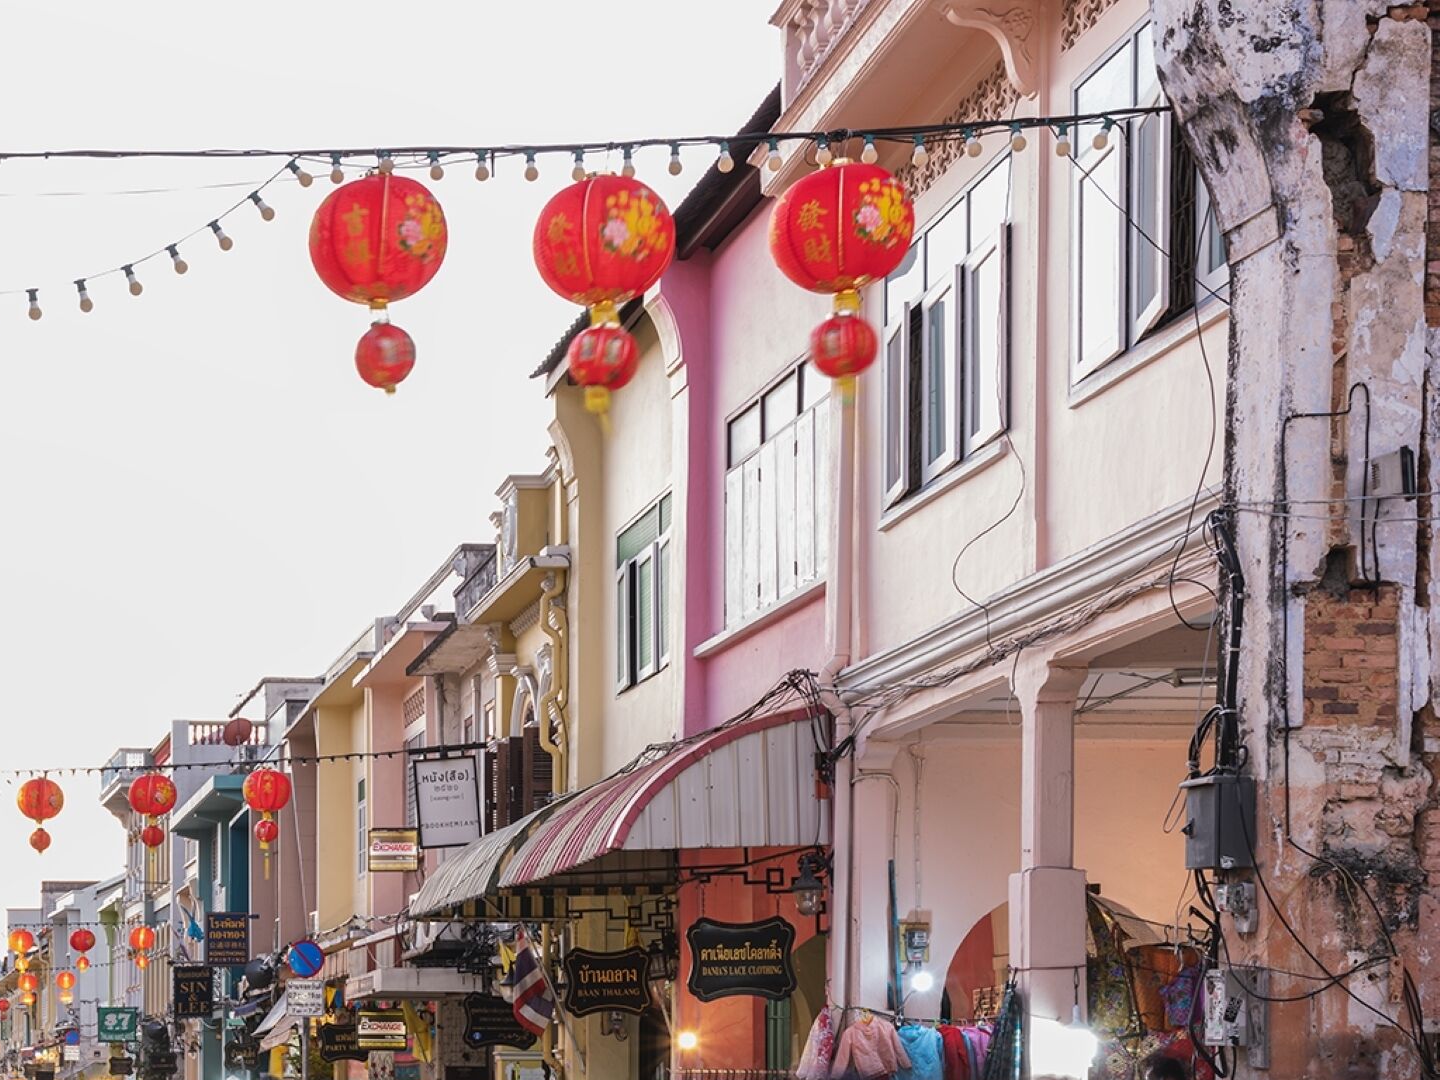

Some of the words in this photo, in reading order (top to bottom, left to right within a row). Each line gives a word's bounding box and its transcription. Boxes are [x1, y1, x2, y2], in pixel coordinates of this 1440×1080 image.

[729, 967, 747, 975] LACE
[748, 966, 782, 975] CLOTHING
[180, 982, 207, 993] SIN
[177, 1002, 209, 1013] LEE
